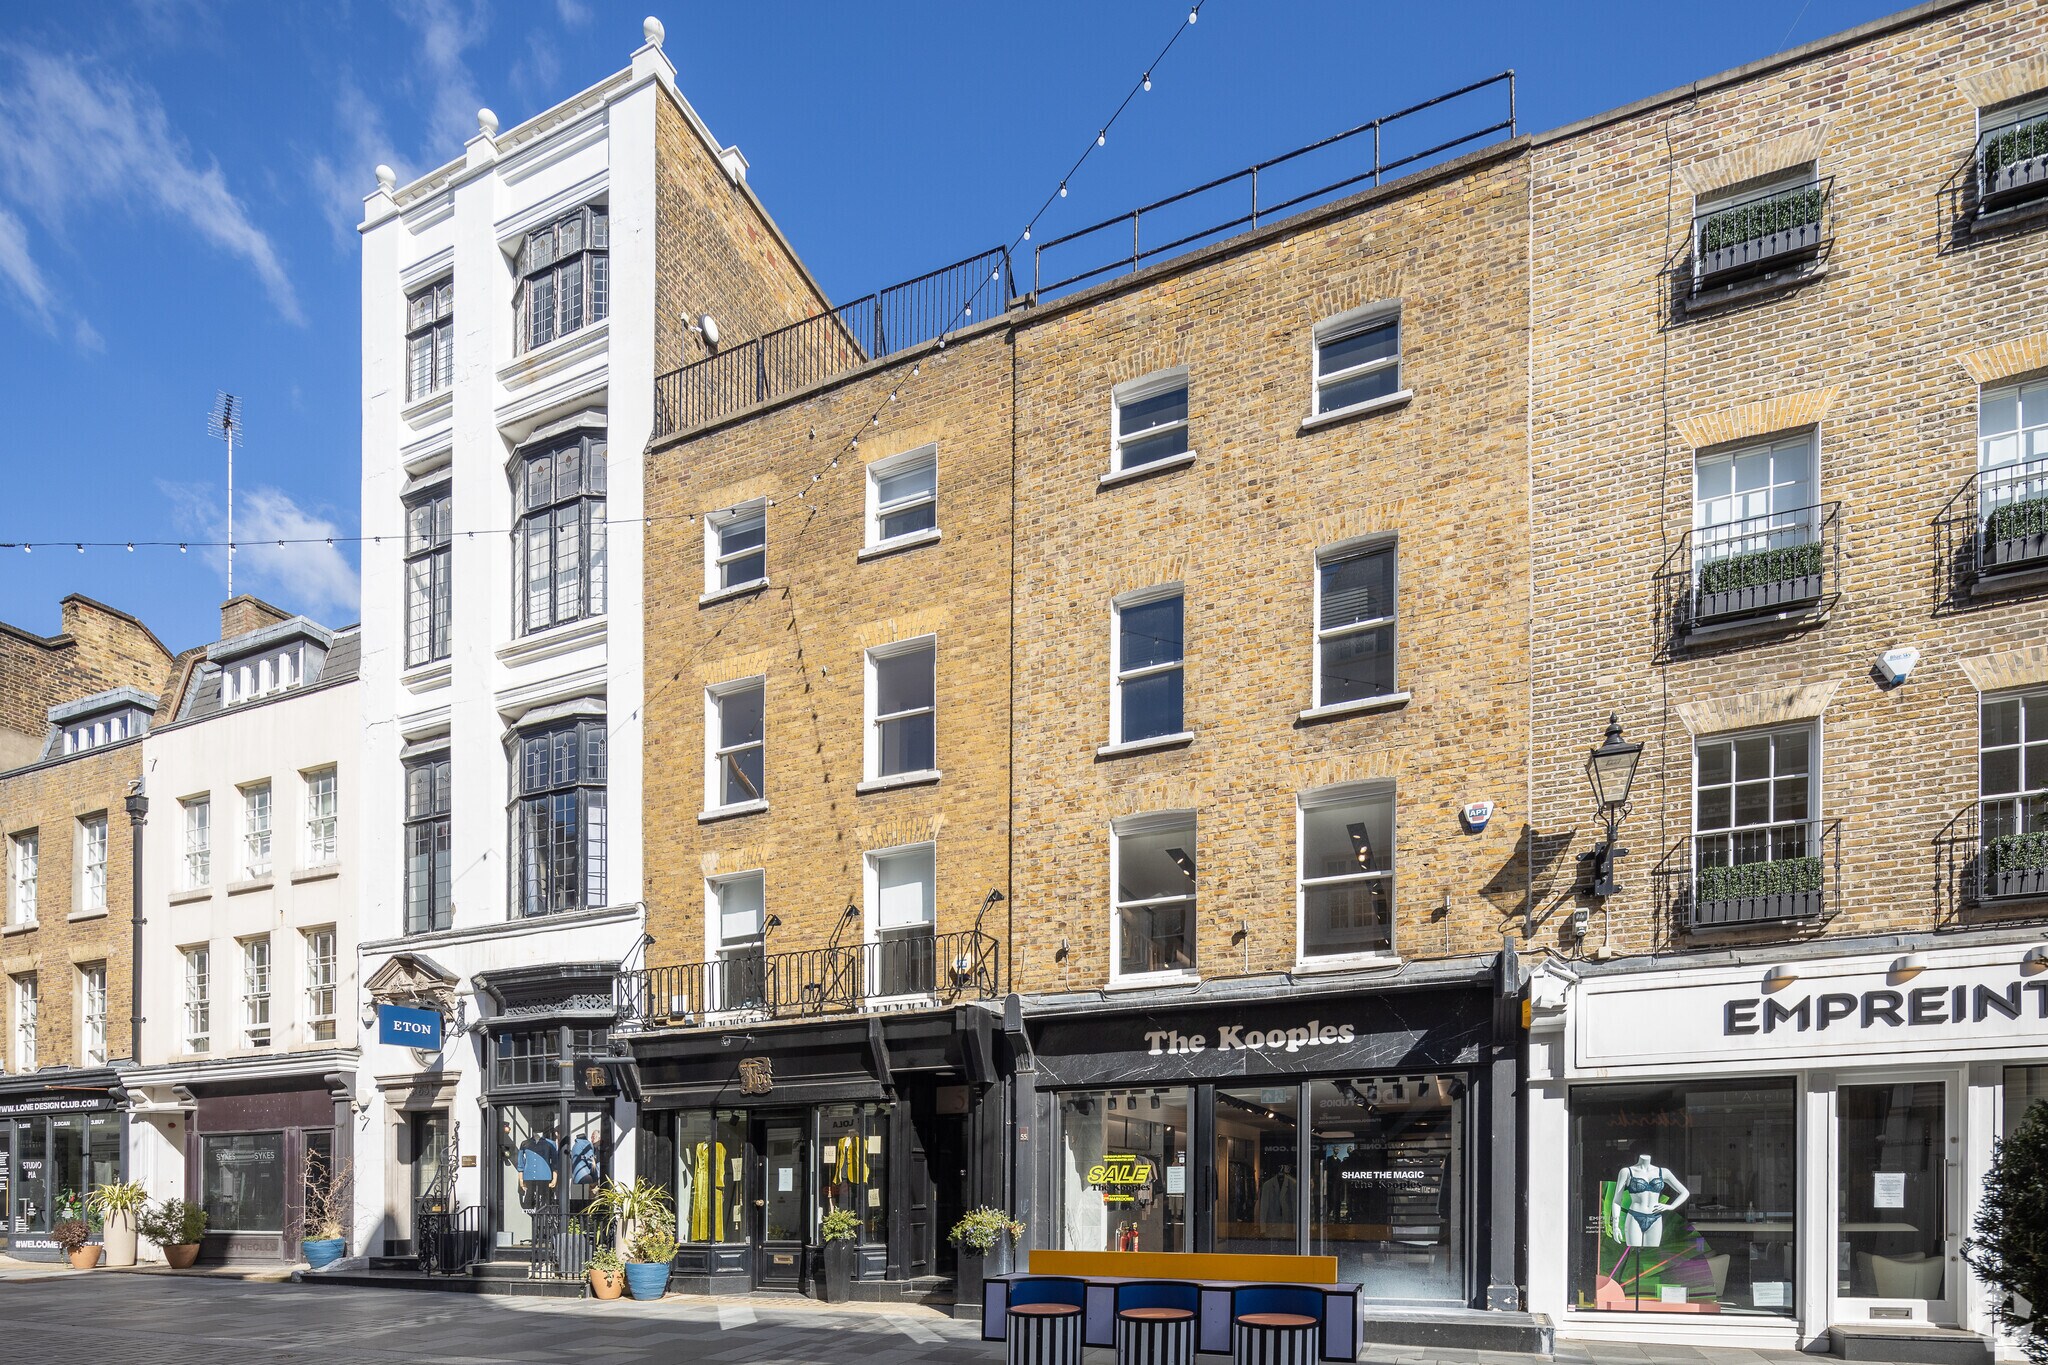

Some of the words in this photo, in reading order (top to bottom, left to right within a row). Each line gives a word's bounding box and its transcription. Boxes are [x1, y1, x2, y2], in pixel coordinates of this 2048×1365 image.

[1470, 808, 1487, 817] APT
[393, 1020, 432, 1034] ETON
[1144, 1030, 1206, 1055] The
[1217, 1020, 1355, 1053] Kooples
[34, 1101, 59, 1110] DESIGN
[216, 1153, 236, 1161] SYKES
[254, 1151, 275, 1160] SYKES
[22, 1161, 42, 1170] STUDIO
[1087, 1164, 1152, 1184] SALE
[1341, 1171, 1373, 1179] SHARE
[1373, 1171, 1392, 1179] THE
[1091, 1183, 1110, 1191] The
[1114, 1183, 1151, 1193] Kooples
[15, 1240, 59, 1249] #WELCOME
